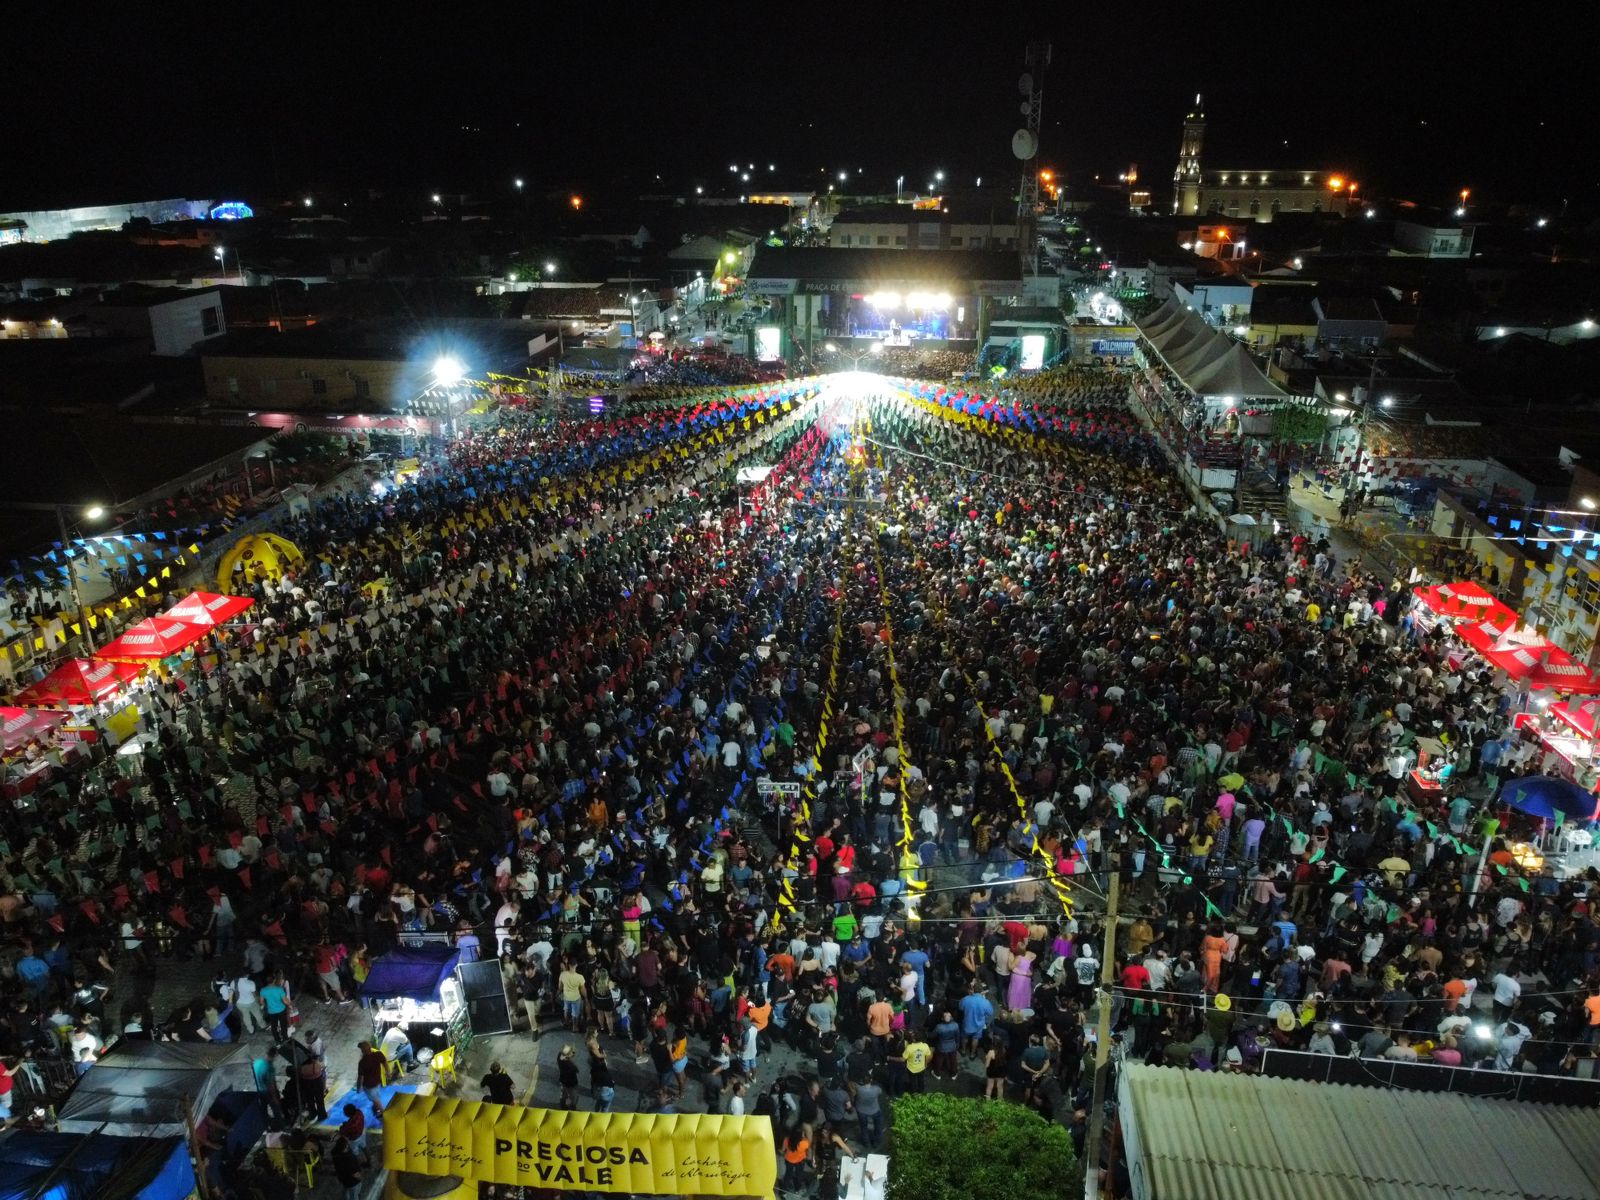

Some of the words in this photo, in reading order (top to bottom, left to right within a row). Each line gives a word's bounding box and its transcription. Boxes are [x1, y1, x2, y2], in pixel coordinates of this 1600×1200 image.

[121, 634, 156, 645] BRAHMA
[1543, 664, 1587, 676] BRAHMA
[495, 1138, 650, 1166] PRECIOSA
[517, 1161, 531, 1169] DO
[534, 1163, 613, 1185] VALE
[680, 1168, 751, 1185] Alambique
